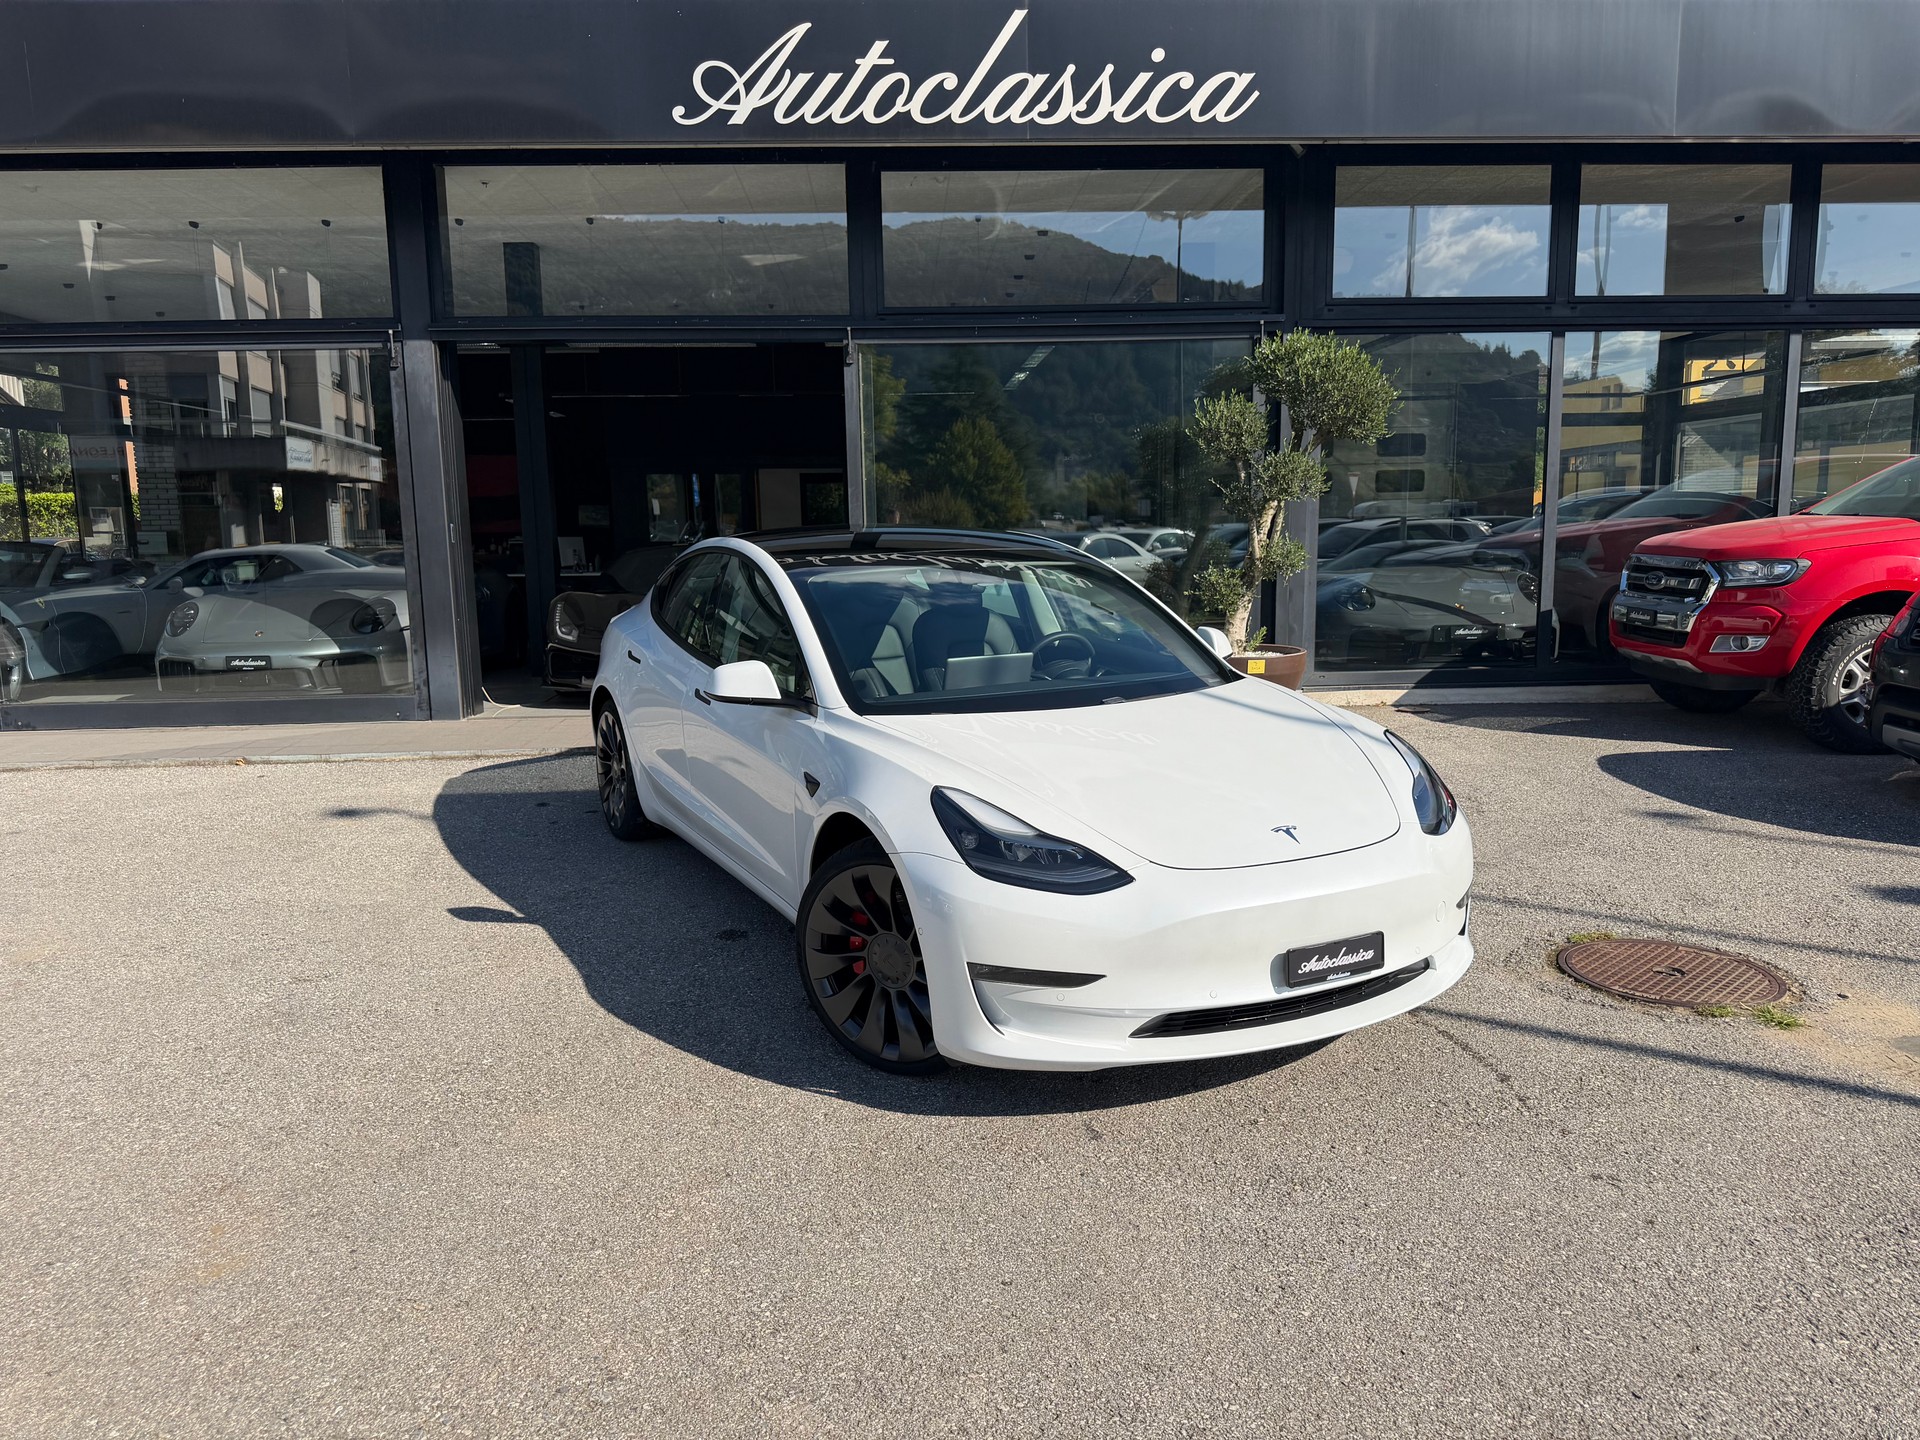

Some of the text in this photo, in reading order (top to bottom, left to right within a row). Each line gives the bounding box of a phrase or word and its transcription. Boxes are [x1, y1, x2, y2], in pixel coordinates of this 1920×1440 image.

[672, 9, 1260, 125] Autoclassica
[1832, 638, 1877, 686] BFGoodric
[1297, 947, 1375, 974] Autoclassica
